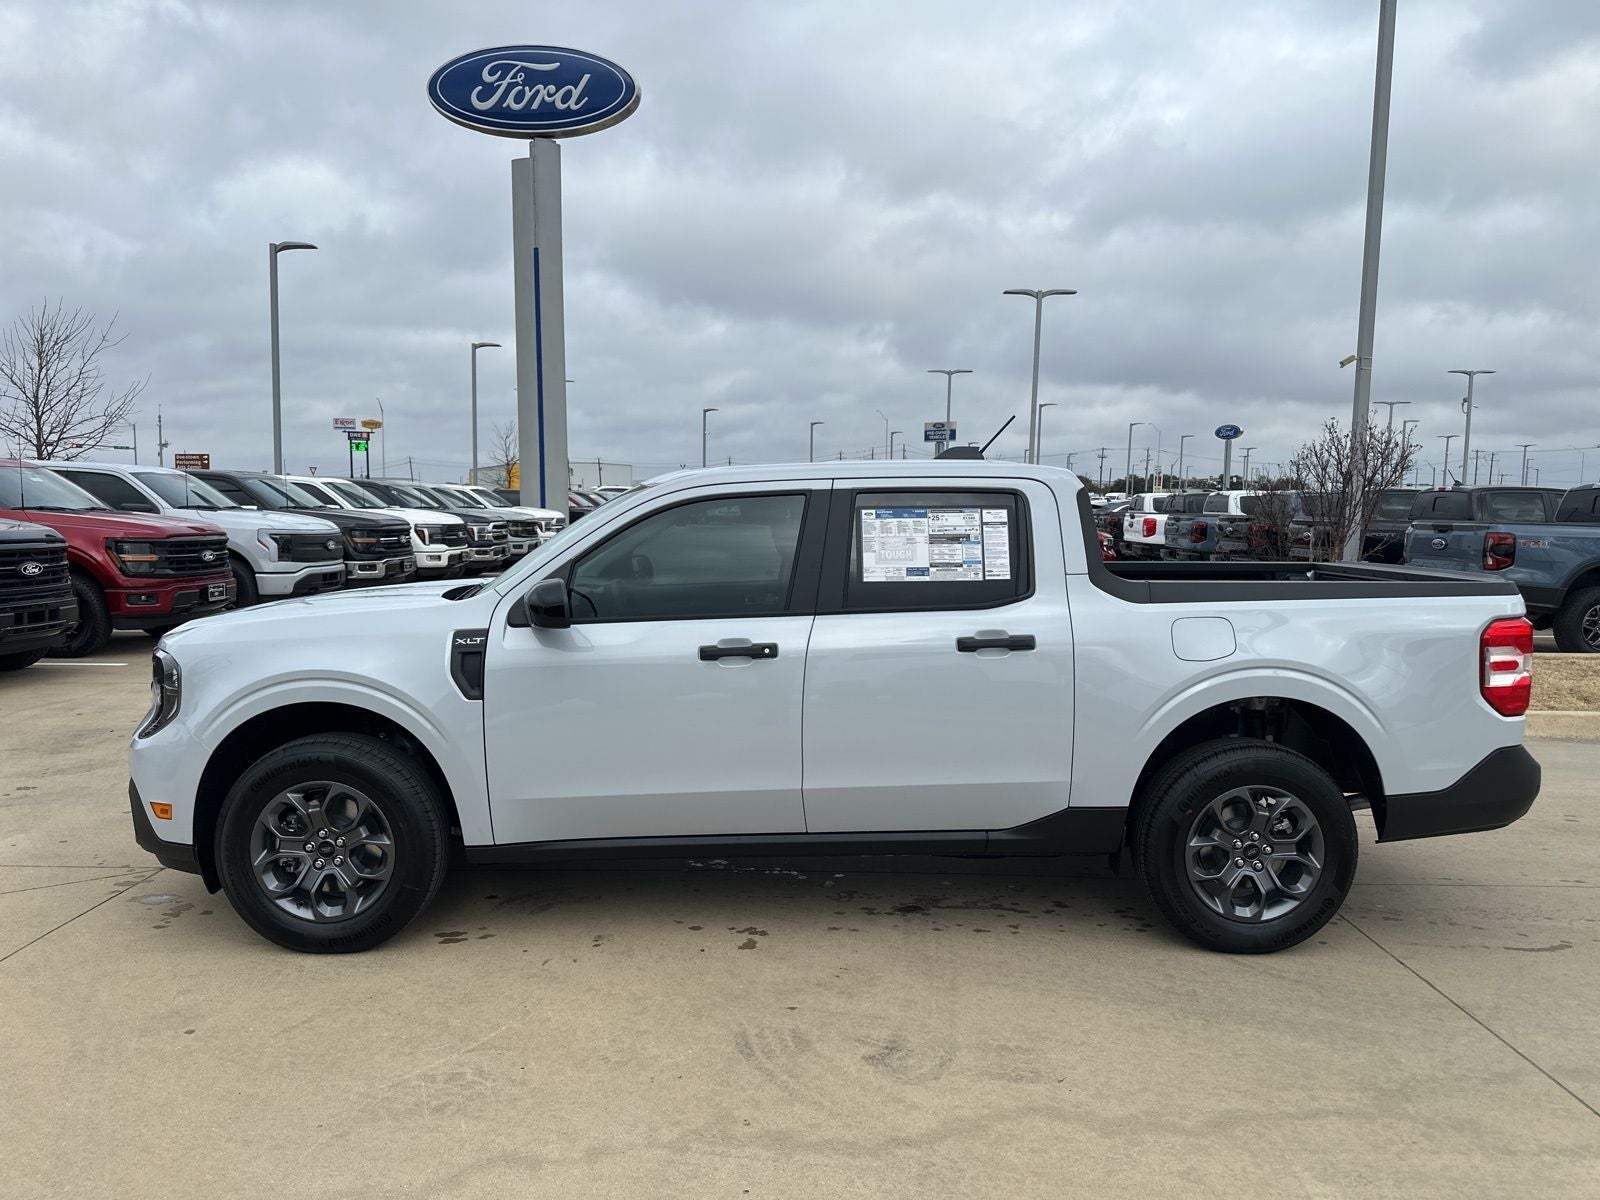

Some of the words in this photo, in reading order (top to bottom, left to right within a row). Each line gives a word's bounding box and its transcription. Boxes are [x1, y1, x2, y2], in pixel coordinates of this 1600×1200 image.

[470, 60, 591, 111] Ford
[335, 419, 354, 427] Exxon
[1219, 427, 1236, 437] Ford
[879, 550, 912, 560] TOUGH
[25, 563, 40, 574] Ford
[455, 637, 486, 645] XLT
